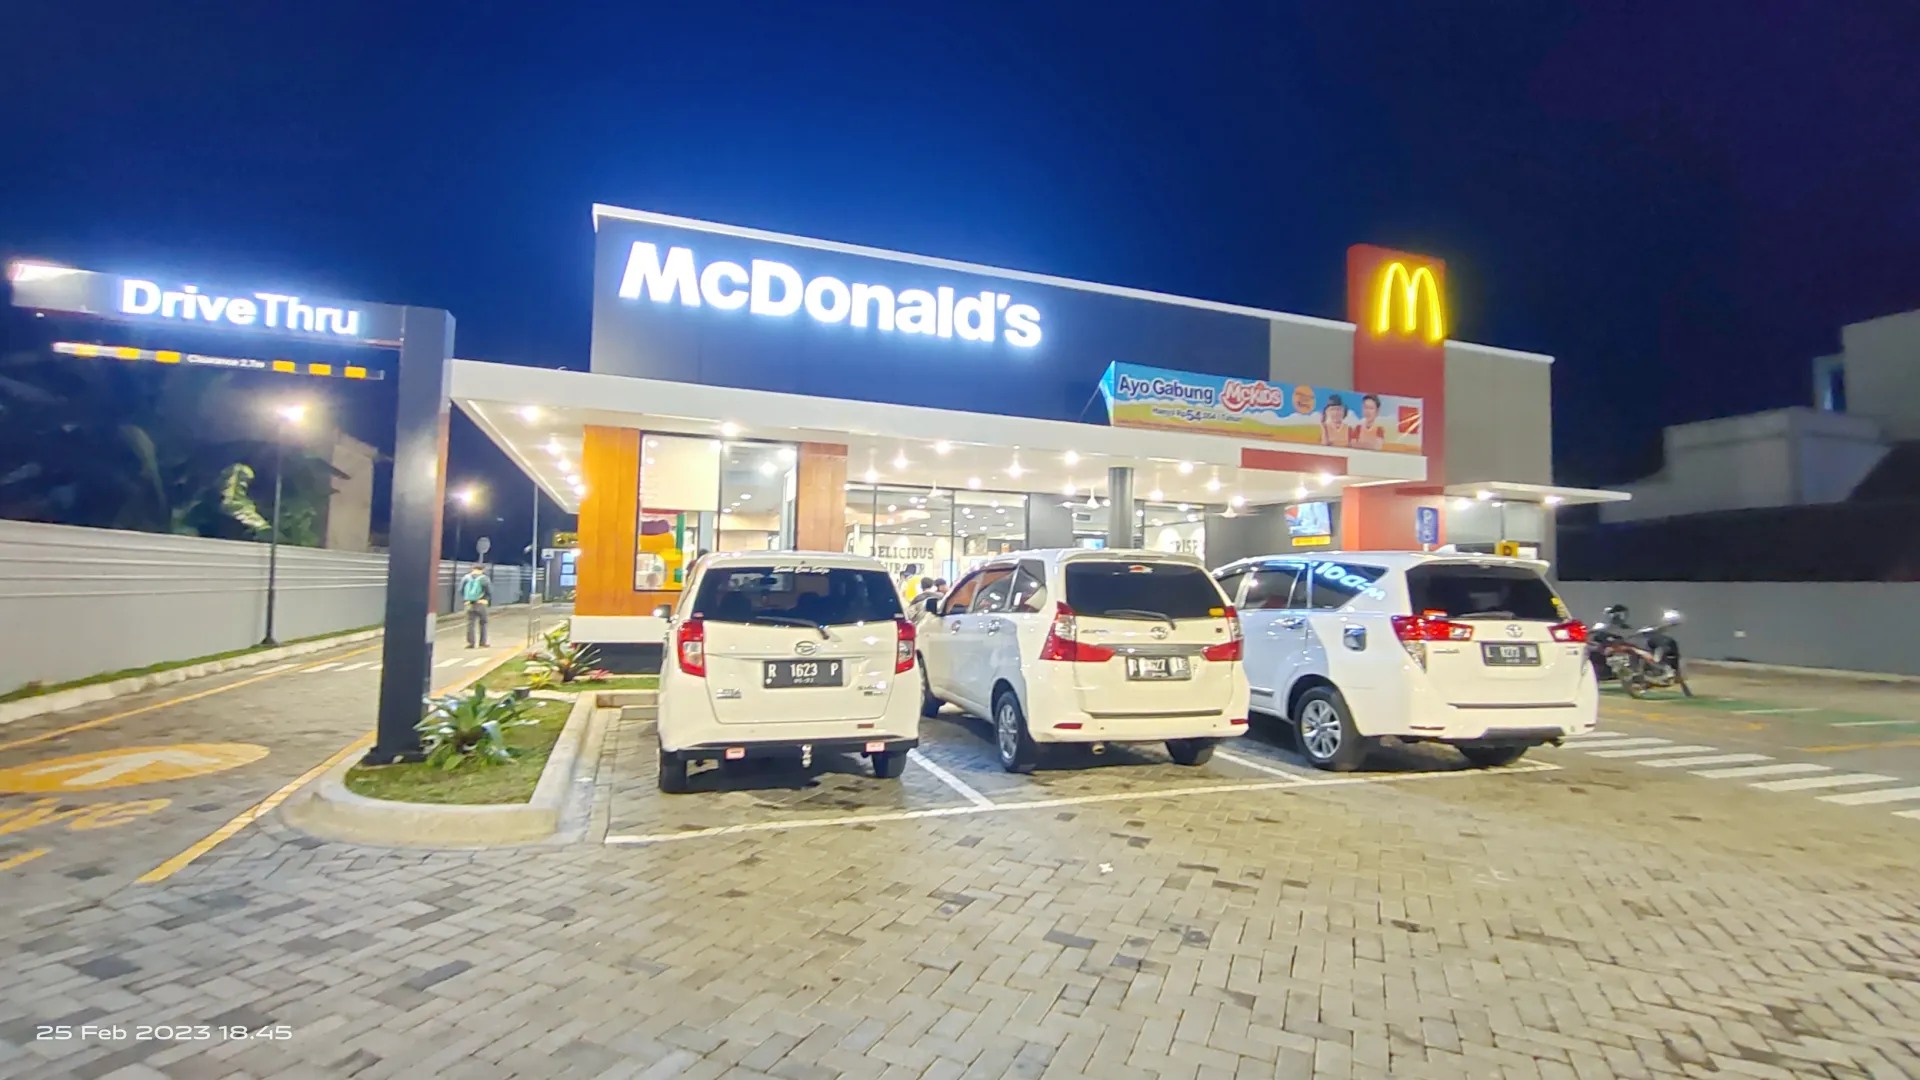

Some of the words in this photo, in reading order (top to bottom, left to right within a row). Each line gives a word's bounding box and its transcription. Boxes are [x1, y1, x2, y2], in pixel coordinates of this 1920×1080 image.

[618, 240, 1042, 348] McDonald's
[1119, 376, 1149, 397] Ayo
[1153, 379, 1213, 404] Gabung
[767, 663, 778, 678] R
[790, 662, 818, 678] 1623
[830, 662, 839, 677] P
